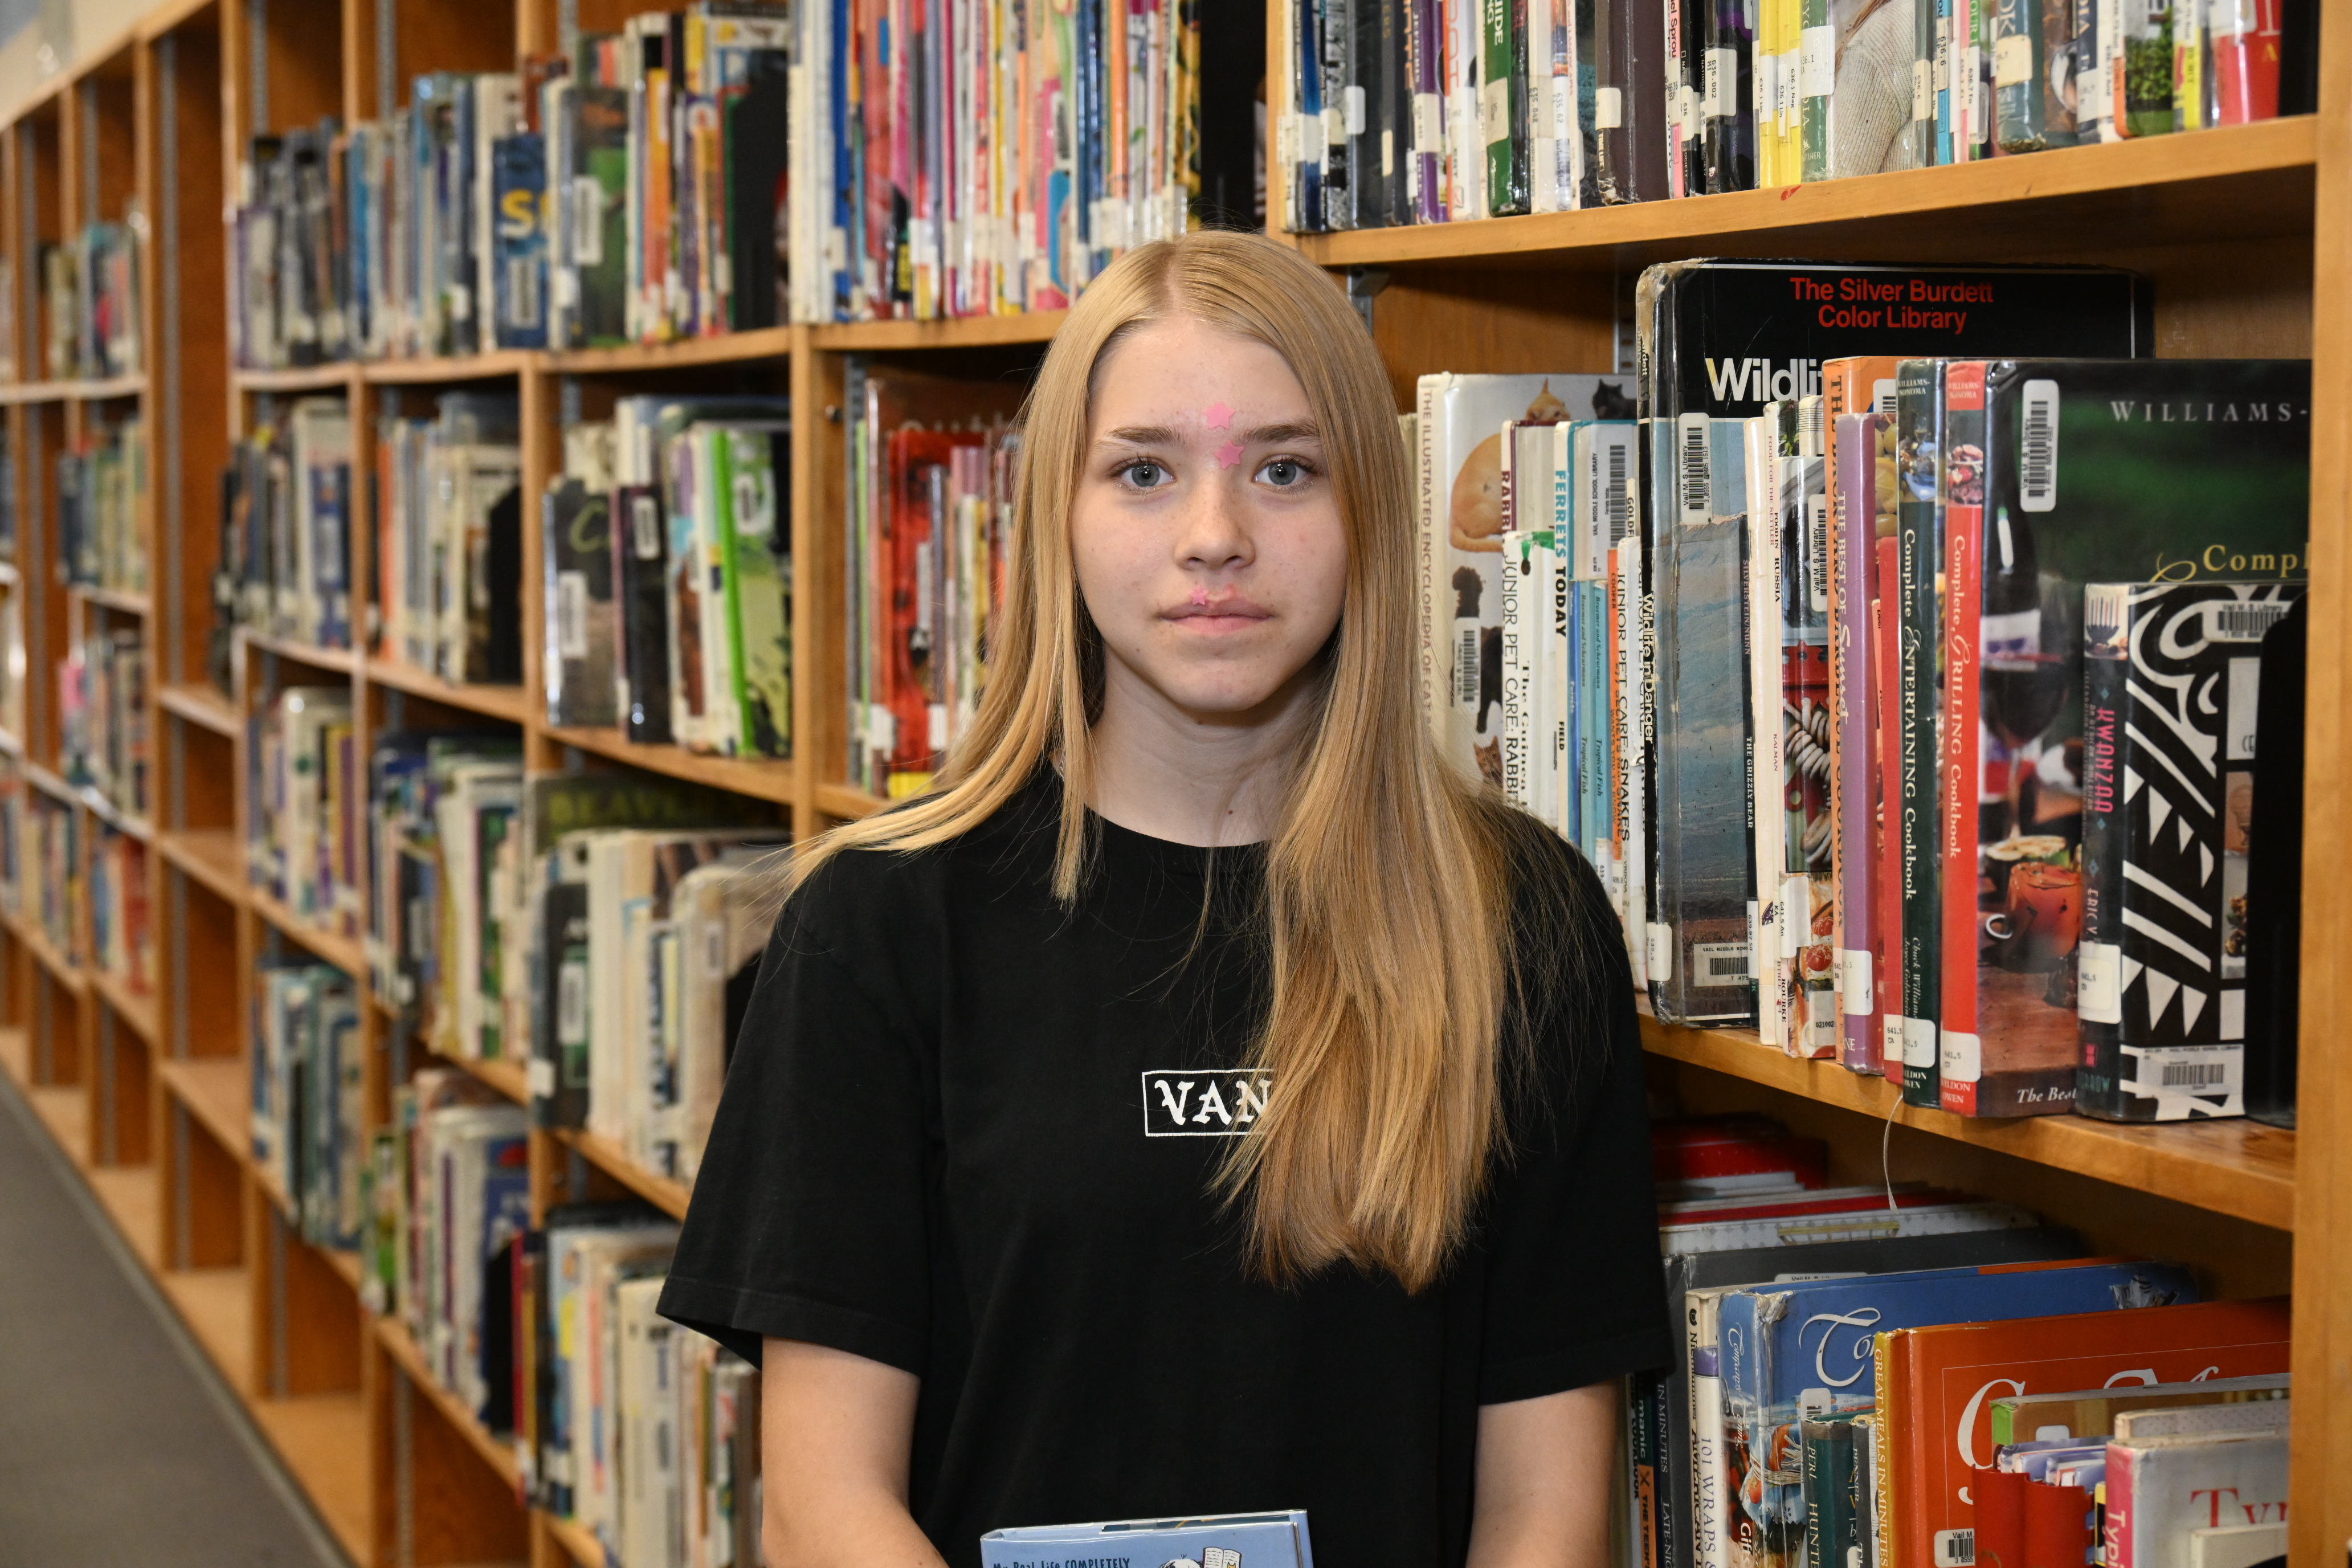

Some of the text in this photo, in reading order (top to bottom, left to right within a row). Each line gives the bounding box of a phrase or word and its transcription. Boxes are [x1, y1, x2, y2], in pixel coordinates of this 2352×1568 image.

[1707, 60, 1712, 72] MI
[1790, 277, 1994, 304] The Silver Burdett
[1818, 305, 1966, 335] Color Library
[2110, 400, 2308, 422] WILLIAMS-
[1683, 481, 1689, 490] M.
[1422, 389, 1433, 673] THE ILLUSTRATED ENCYCLOPEDIA OF
[1555, 470, 1567, 638] FERRETS TODAY
[1775, 538, 1779, 549] IN
[1618, 574, 1628, 641] JUNIOR
[1742, 559, 1751, 655] SILVERSTEIN/NUNN
[1837, 491, 1851, 725] THE BEST OF Sunset
[1503, 556, 1518, 733] JUNIOR PET CARE:
[1618, 649, 1627, 687] PET
[1642, 593, 1655, 744] Wildlife in Danger
[1902, 529, 1922, 901] Complete ENTERTAINING Cookbook
[1949, 534, 1974, 860] Complete GRILLING Cookbook
[1520, 660, 1530, 791] The Guinea
[1612, 774, 1616, 789] TO
[2095, 707, 2115, 812] KWANZAA
[1620, 758, 1630, 842] SNAKES
[1774, 905, 1779, 916] KA
[1780, 925, 1785, 937] An
[2086, 888, 2099, 919] ERIC
[1912, 937, 1921, 969] Chuck
[2017, 1086, 2077, 1104] The Best
[1657, 1384, 1668, 1473] IN MINUTES
[1808, 1447, 1818, 1481] PERL
[1874, 1348, 1889, 1567] GREAT MEALS IN MINUTES
[1701, 1438, 1716, 1553] 101 WRAPS
[1740, 1522, 1753, 1565] Gifts
